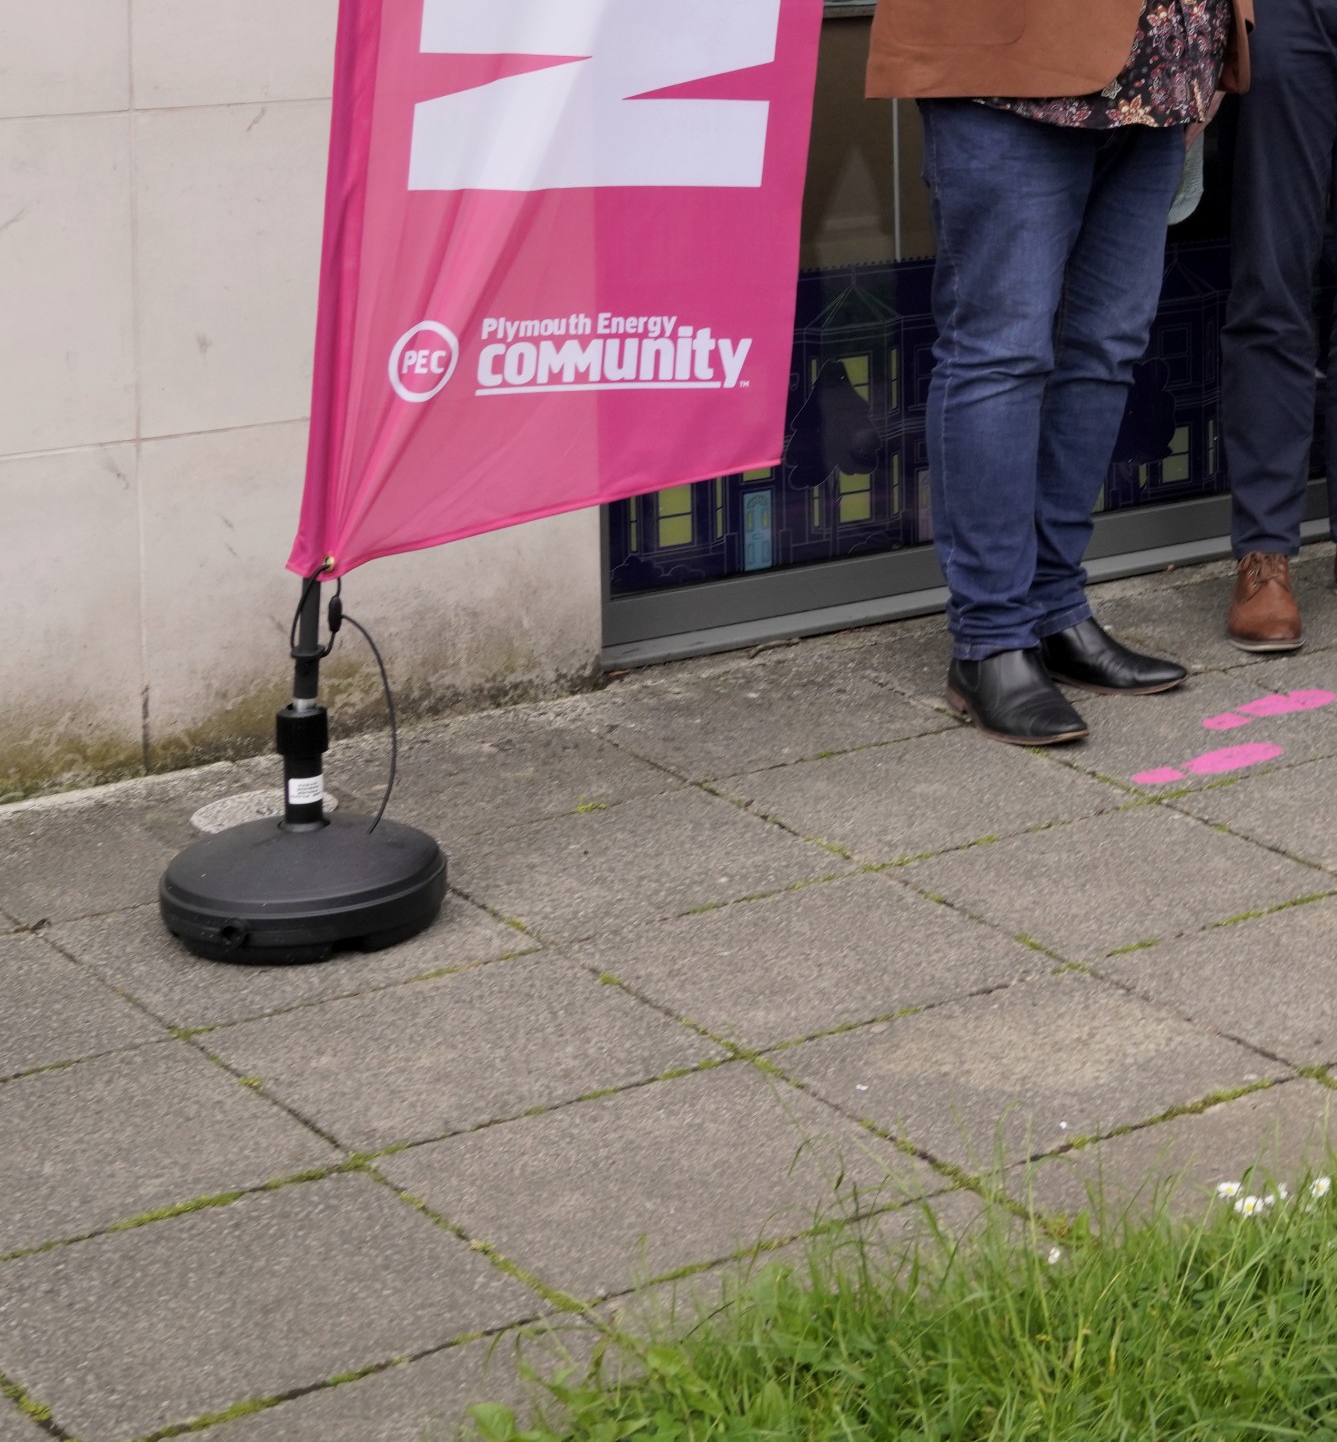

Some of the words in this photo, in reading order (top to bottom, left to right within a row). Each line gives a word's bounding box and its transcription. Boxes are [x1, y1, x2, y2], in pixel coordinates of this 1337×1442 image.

[481, 313, 592, 342] Plymouth
[597, 312, 677, 338] Energy
[401, 349, 447, 376] PEC
